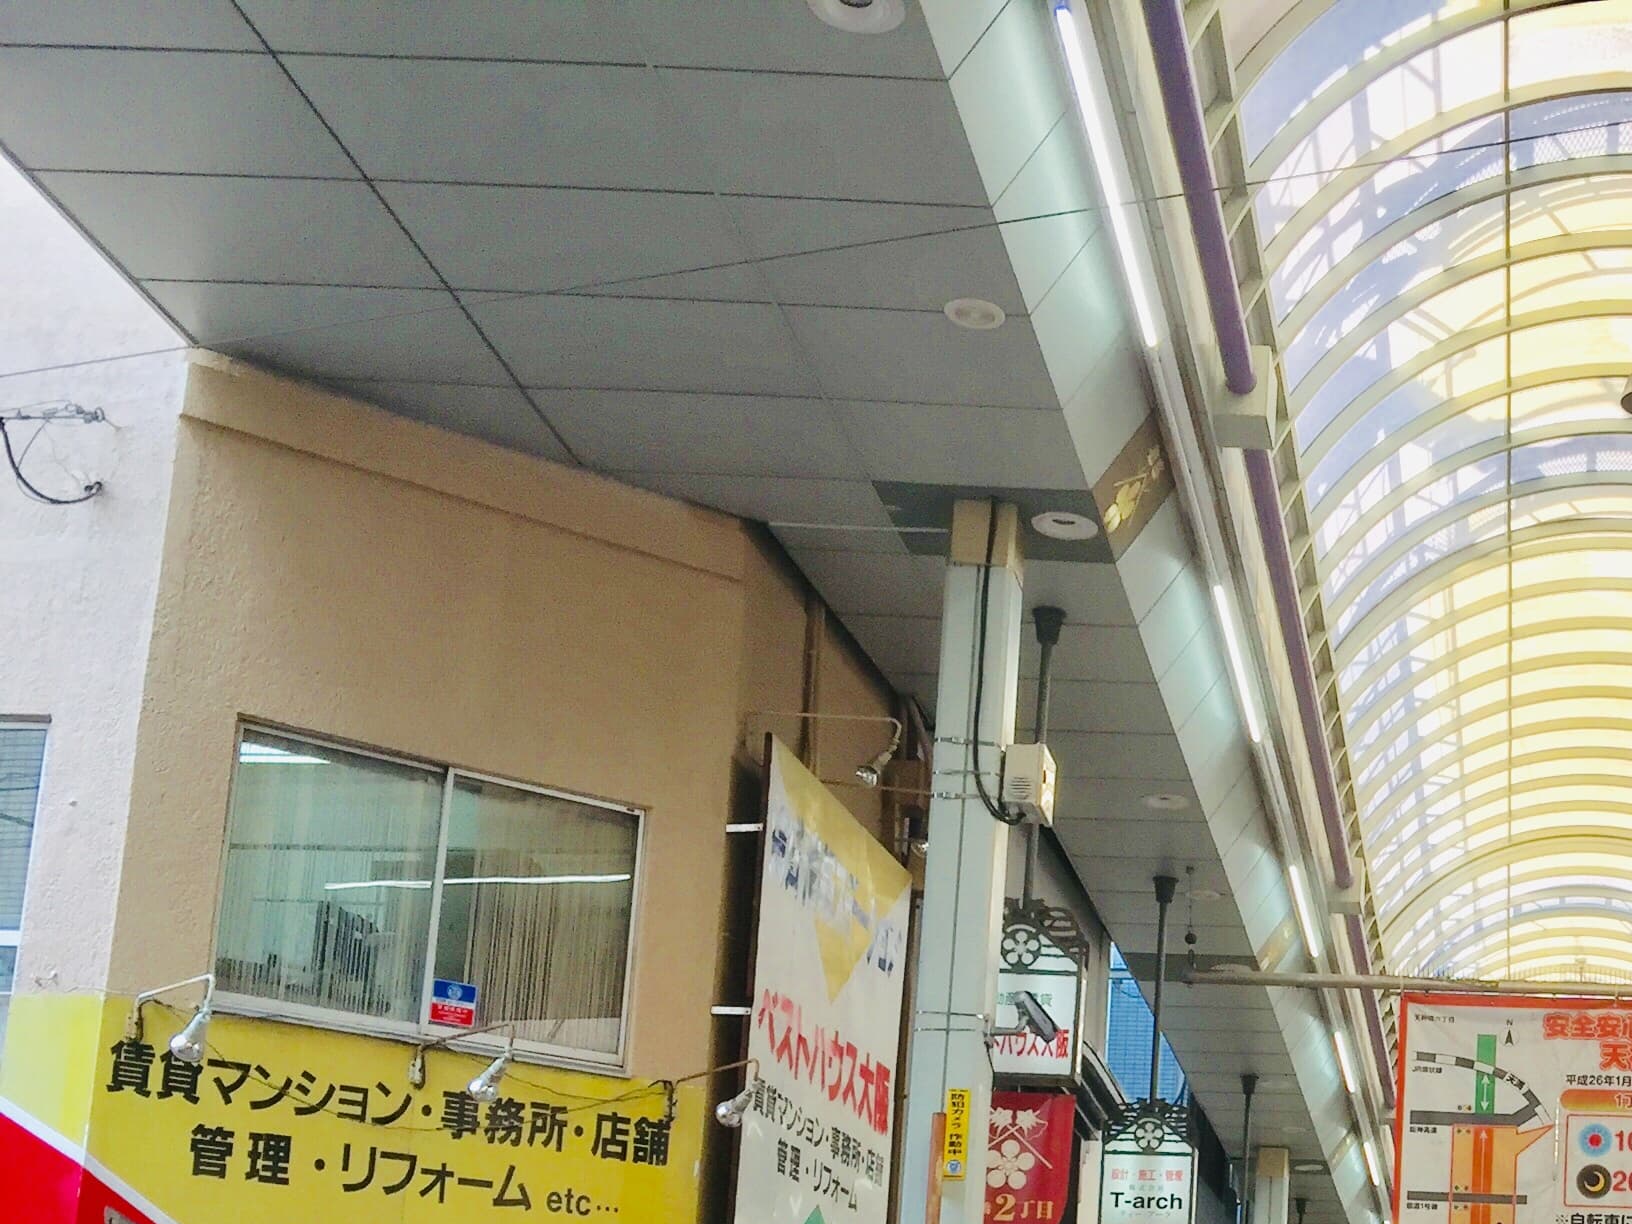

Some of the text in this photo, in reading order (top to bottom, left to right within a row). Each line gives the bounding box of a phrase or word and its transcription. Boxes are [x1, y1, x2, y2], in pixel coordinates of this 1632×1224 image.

[106, 1038, 671, 1167] 賃貸マンション・事務所・店舗
[758, 988, 891, 1136] ベストハウス大阪
[1506, 1074, 1526, 1090] 天満
[190, 1123, 532, 1212] 管理・リフォーム
[1110, 1191, 1182, 1210] T-arch
